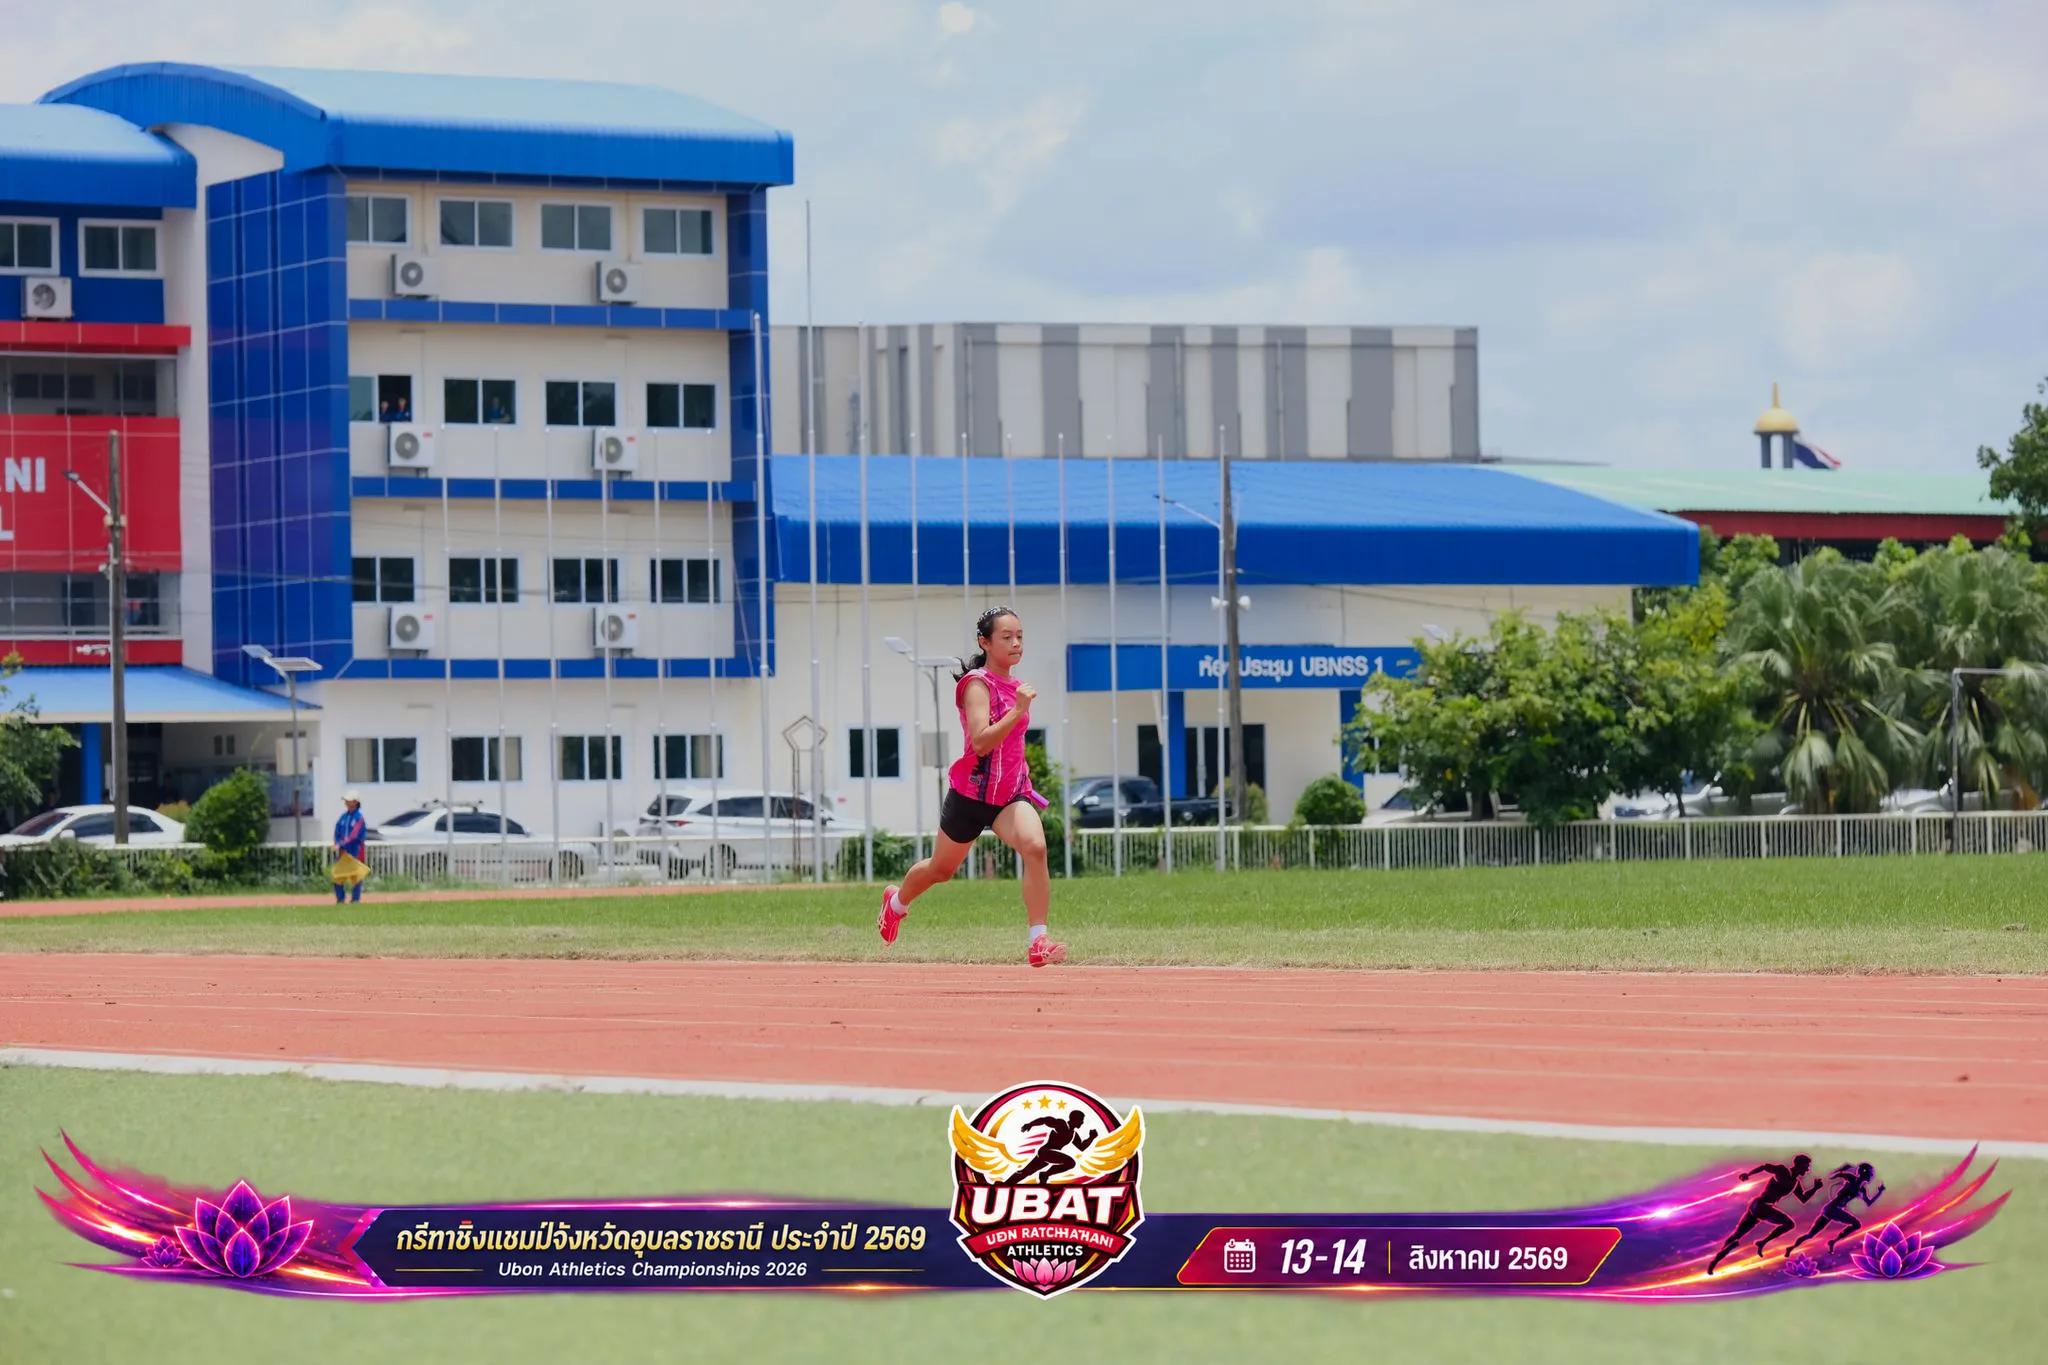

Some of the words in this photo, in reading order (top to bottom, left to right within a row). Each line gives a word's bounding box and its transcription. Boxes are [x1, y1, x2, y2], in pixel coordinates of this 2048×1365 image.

[0, 457, 46, 493] NI
[1198, 654, 1294, 683] ห้อประชุม
[1301, 655, 1369, 677] UBNSS
[1373, 656, 1384, 674] 1
